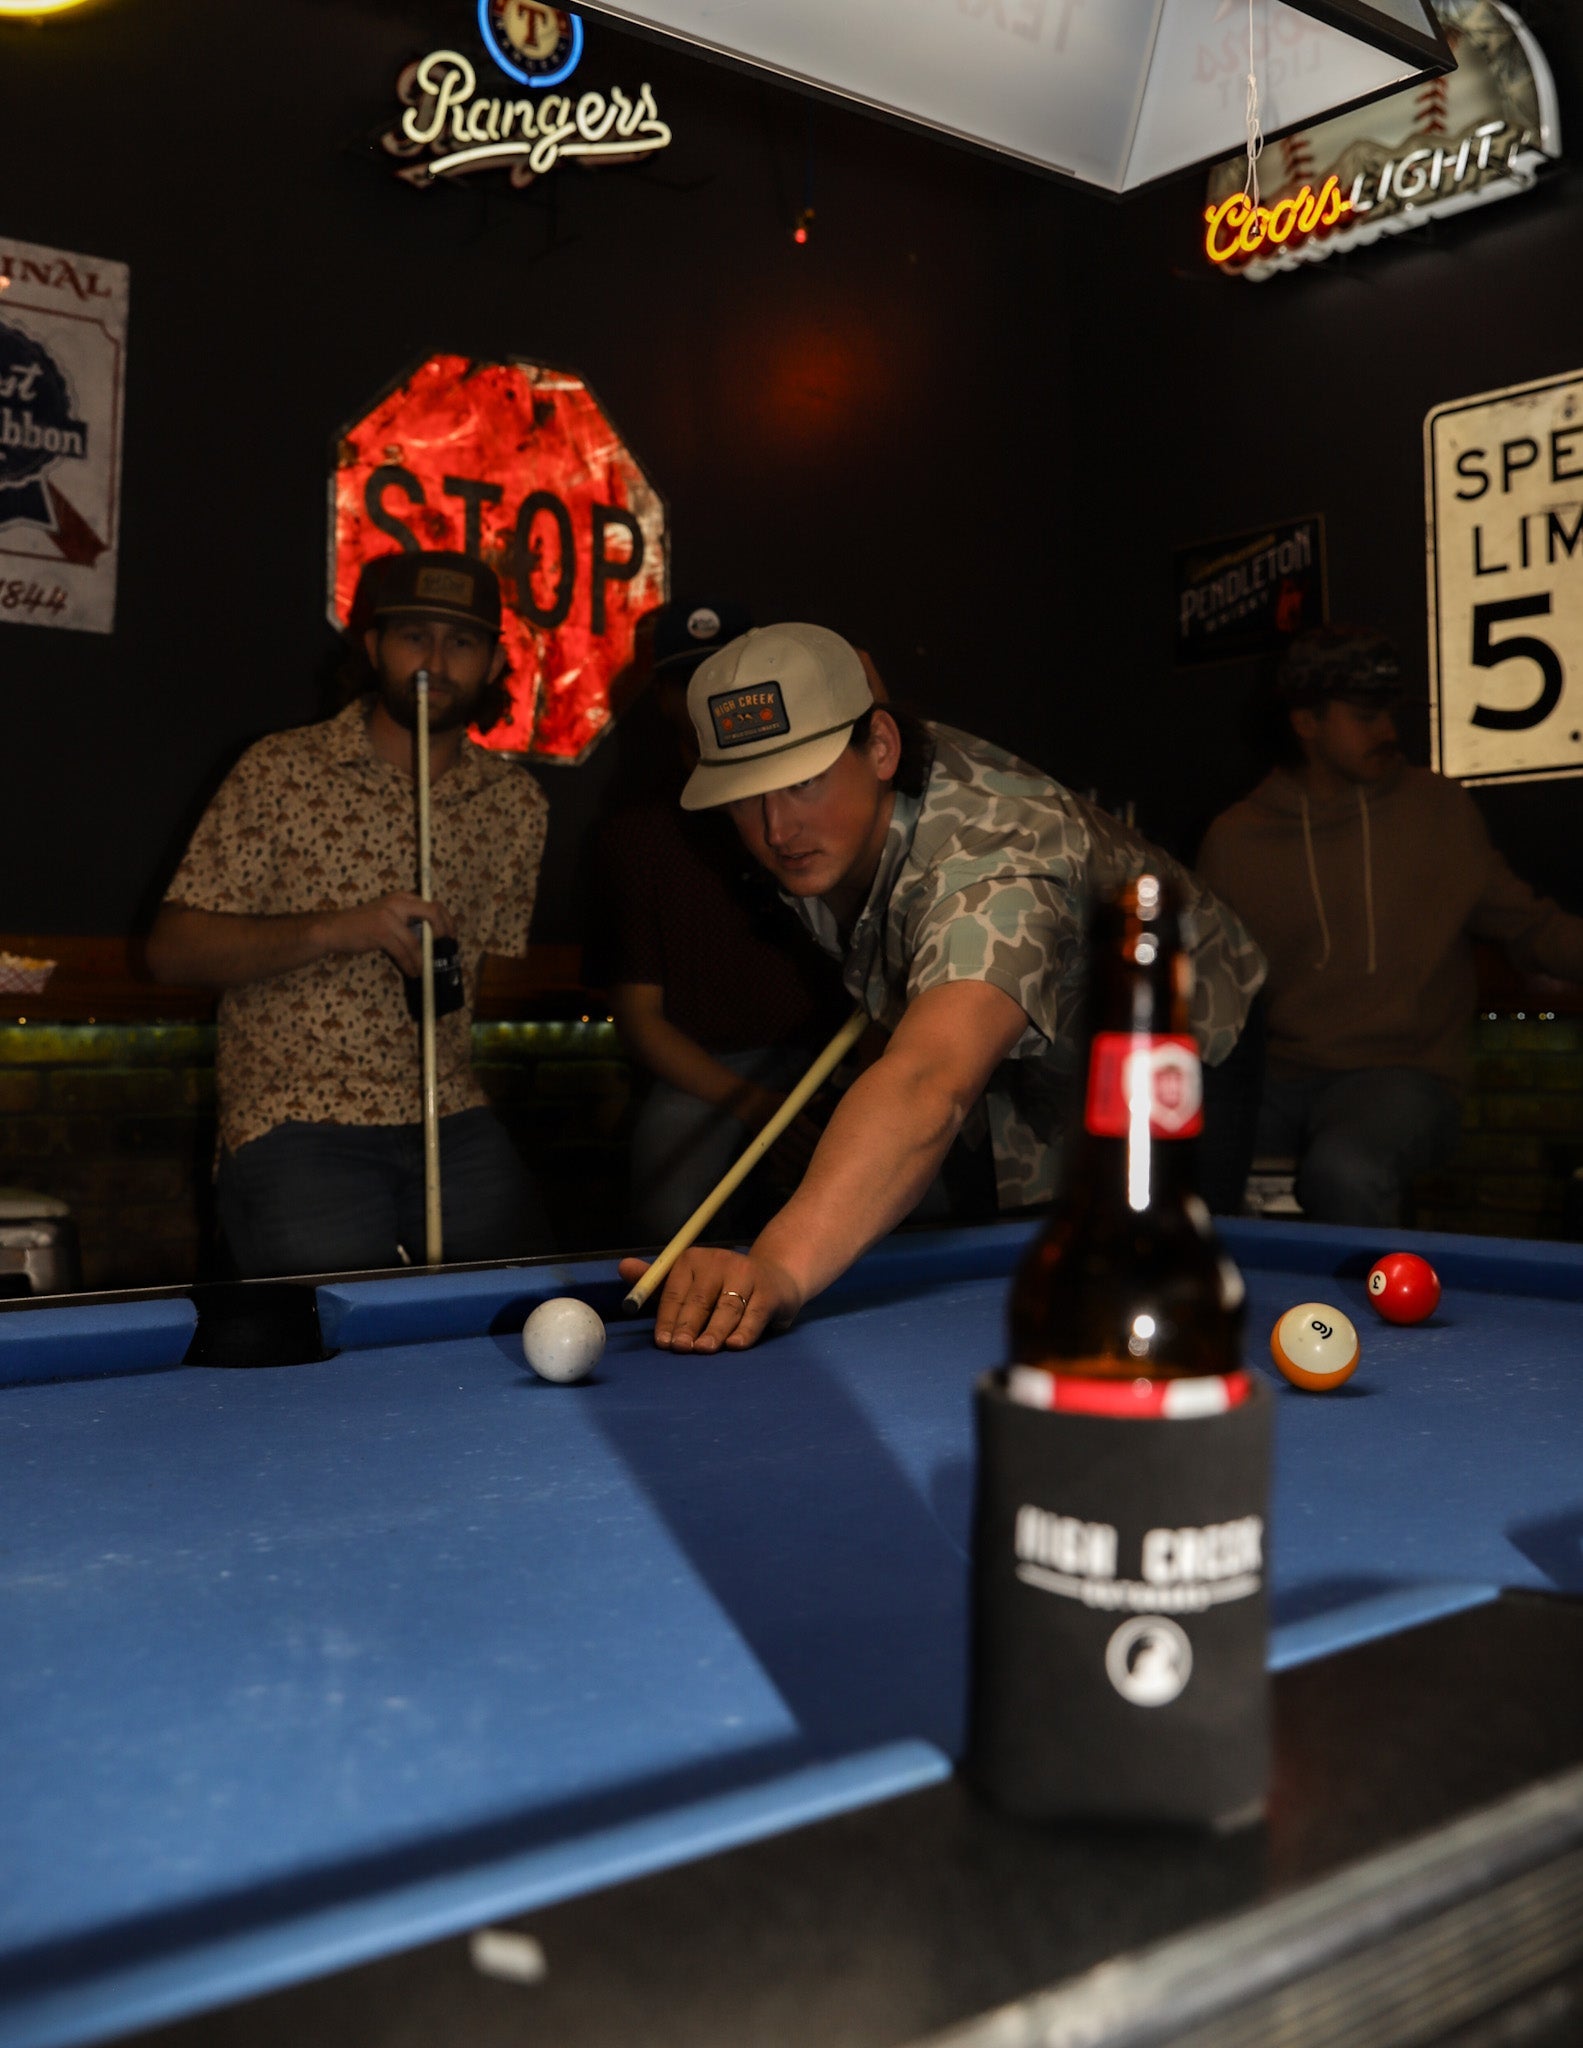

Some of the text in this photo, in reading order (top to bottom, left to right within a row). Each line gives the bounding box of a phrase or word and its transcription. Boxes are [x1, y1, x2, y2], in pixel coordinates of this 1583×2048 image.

[517, 3, 546, 47] T
[402, 50, 672, 173] Rangers
[1204, 120, 1506, 263] Coors LIGHT
[1455, 424, 1583, 502] SPE
[364, 464, 645, 636] STOP
[1473, 506, 1583, 577] LIM
[1470, 591, 1564, 732] 5
[713, 692, 774, 718] HIGH CREEK
[1373, 1274, 1381, 1290] 3
